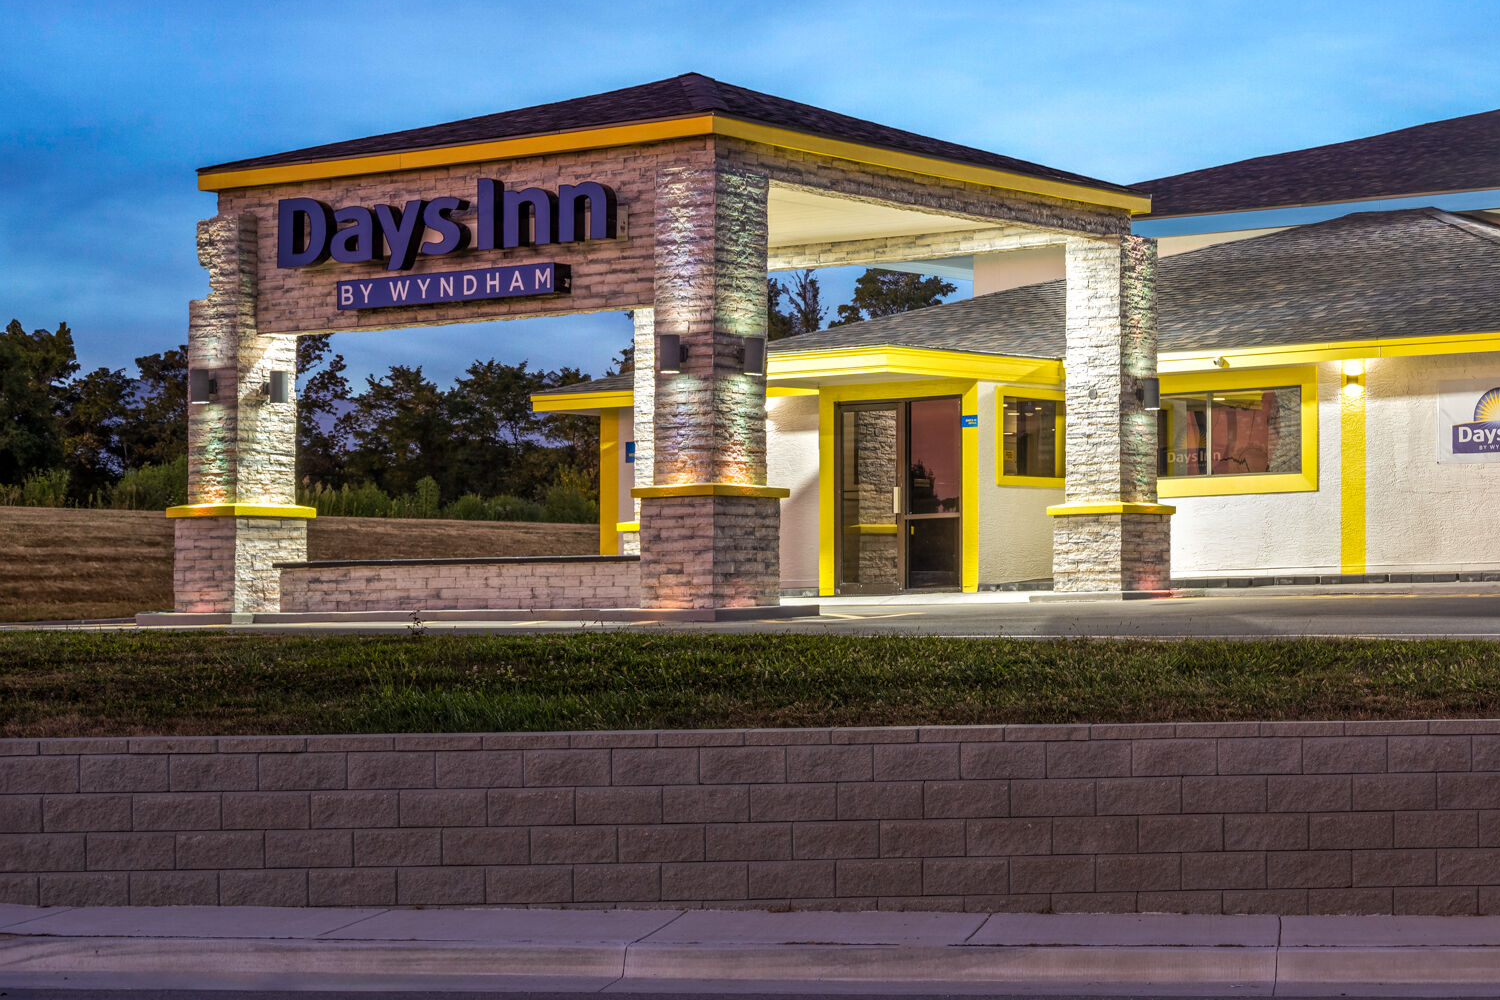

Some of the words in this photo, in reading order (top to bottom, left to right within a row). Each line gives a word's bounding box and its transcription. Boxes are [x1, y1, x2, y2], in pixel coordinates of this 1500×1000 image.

[277, 197, 471, 270] Days
[477, 178, 616, 250] Inn
[341, 284, 373, 306] BY
[389, 267, 551, 301] WYNDHAM
[1167, 452, 1198, 464] Days
[1200, 450, 1220, 462] In
